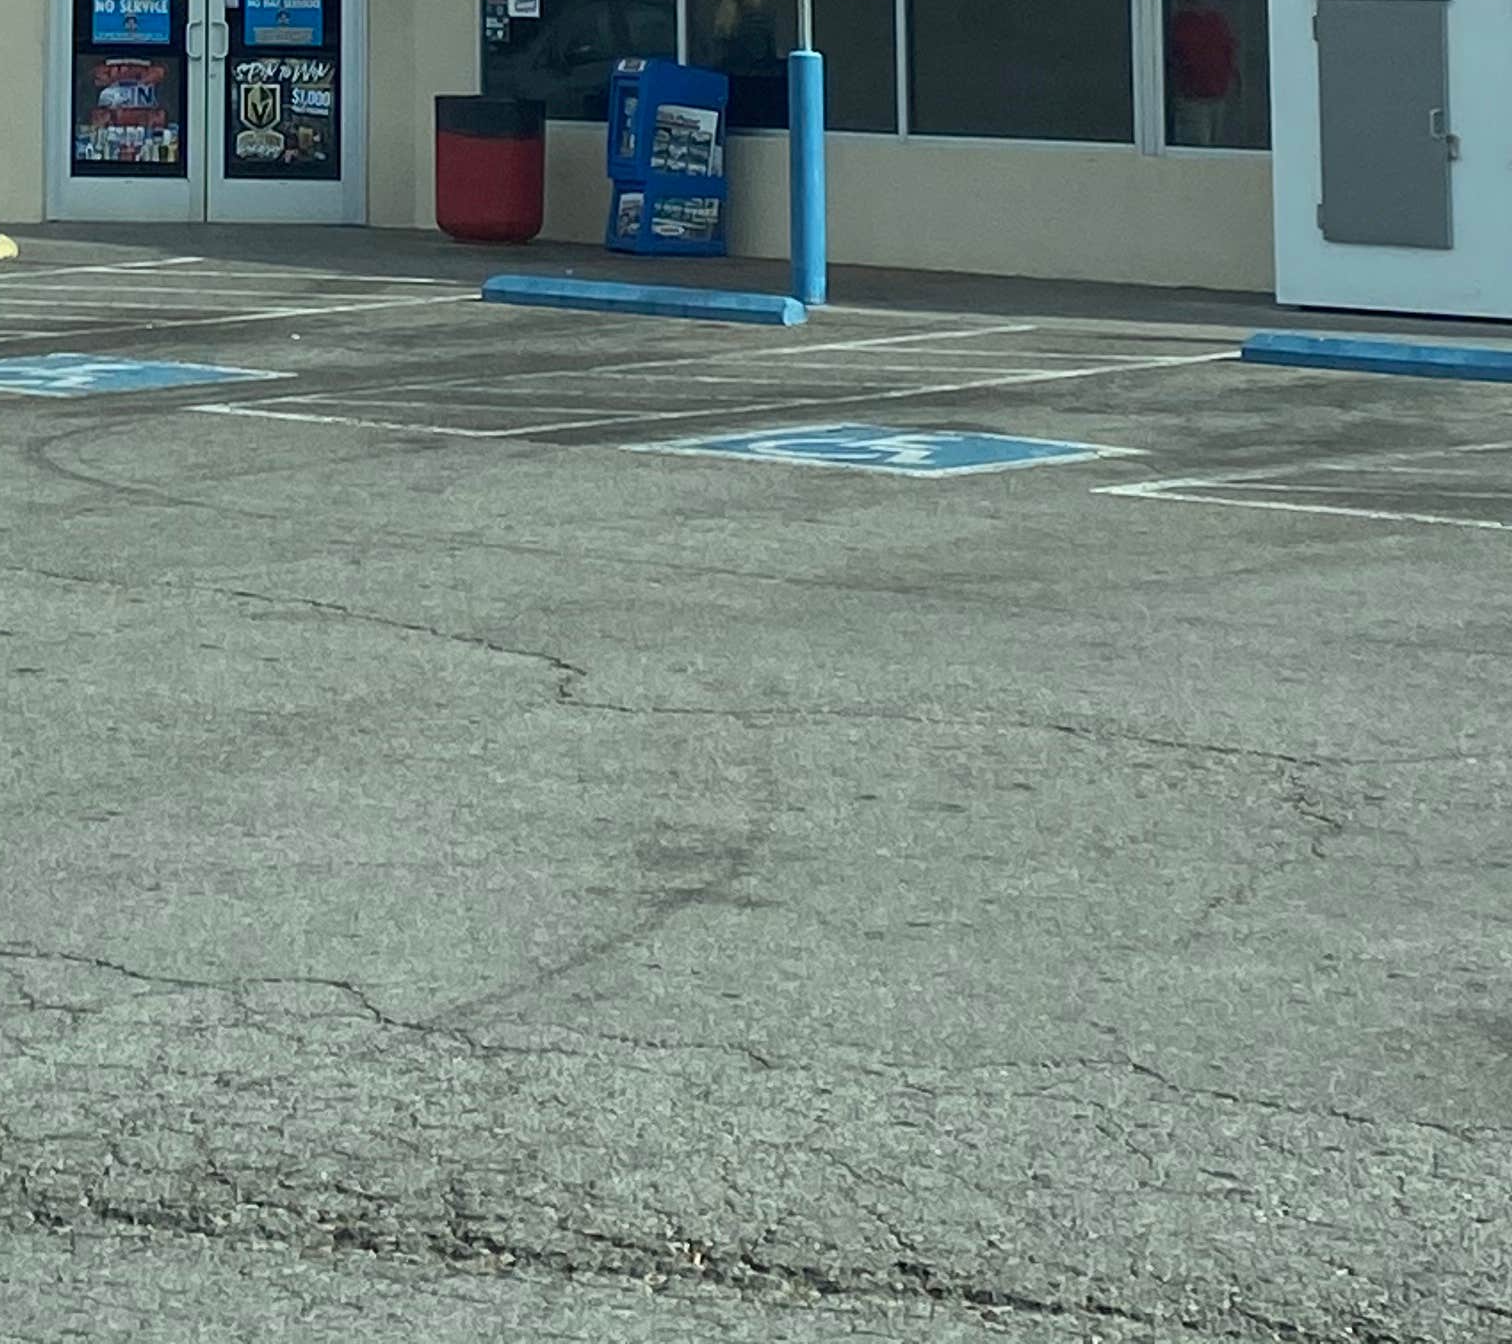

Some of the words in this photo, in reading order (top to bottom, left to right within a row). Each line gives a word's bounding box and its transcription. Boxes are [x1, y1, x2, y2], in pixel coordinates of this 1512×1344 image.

[94, 0, 115, 13] NO
[119, 0, 168, 14] SERVICE
[291, 88, 330, 108] $1,000
